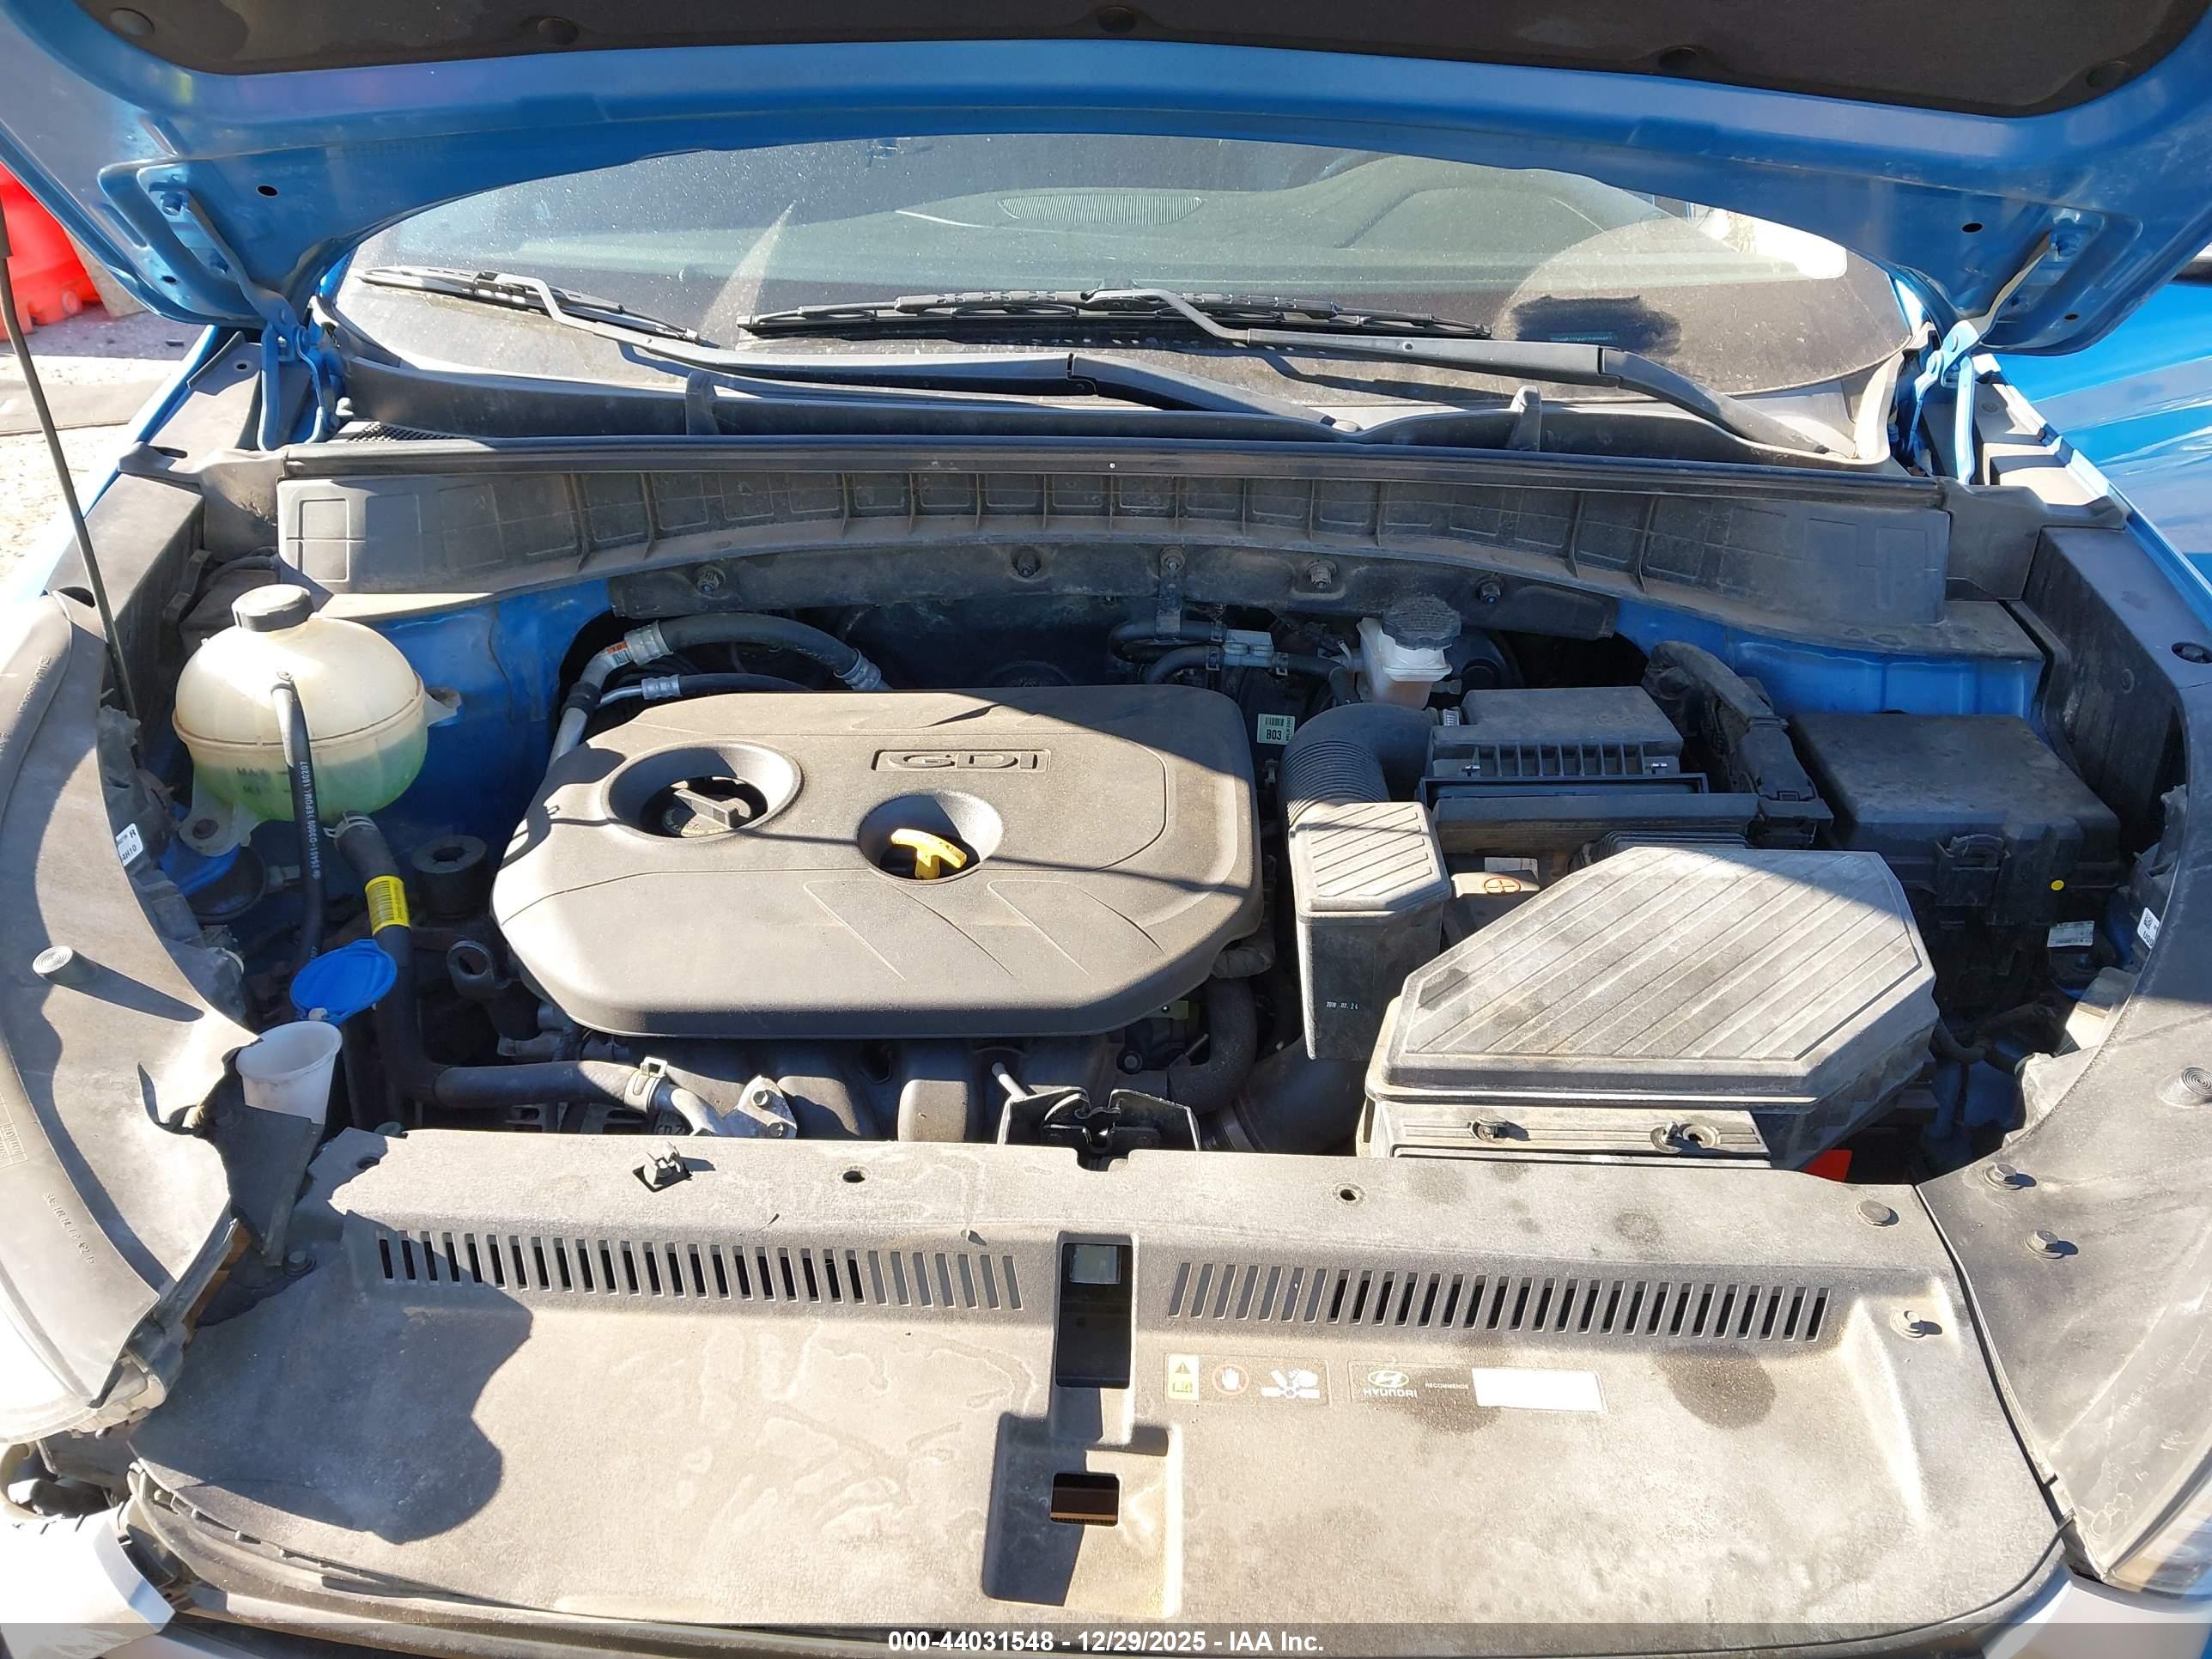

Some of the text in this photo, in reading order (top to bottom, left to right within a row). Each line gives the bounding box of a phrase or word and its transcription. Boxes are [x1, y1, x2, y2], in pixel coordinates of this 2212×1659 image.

[1266, 728, 1283, 741] B03
[888, 752, 1038, 769] GDI
[1363, 1388, 1418, 1399] HYUNDAI
